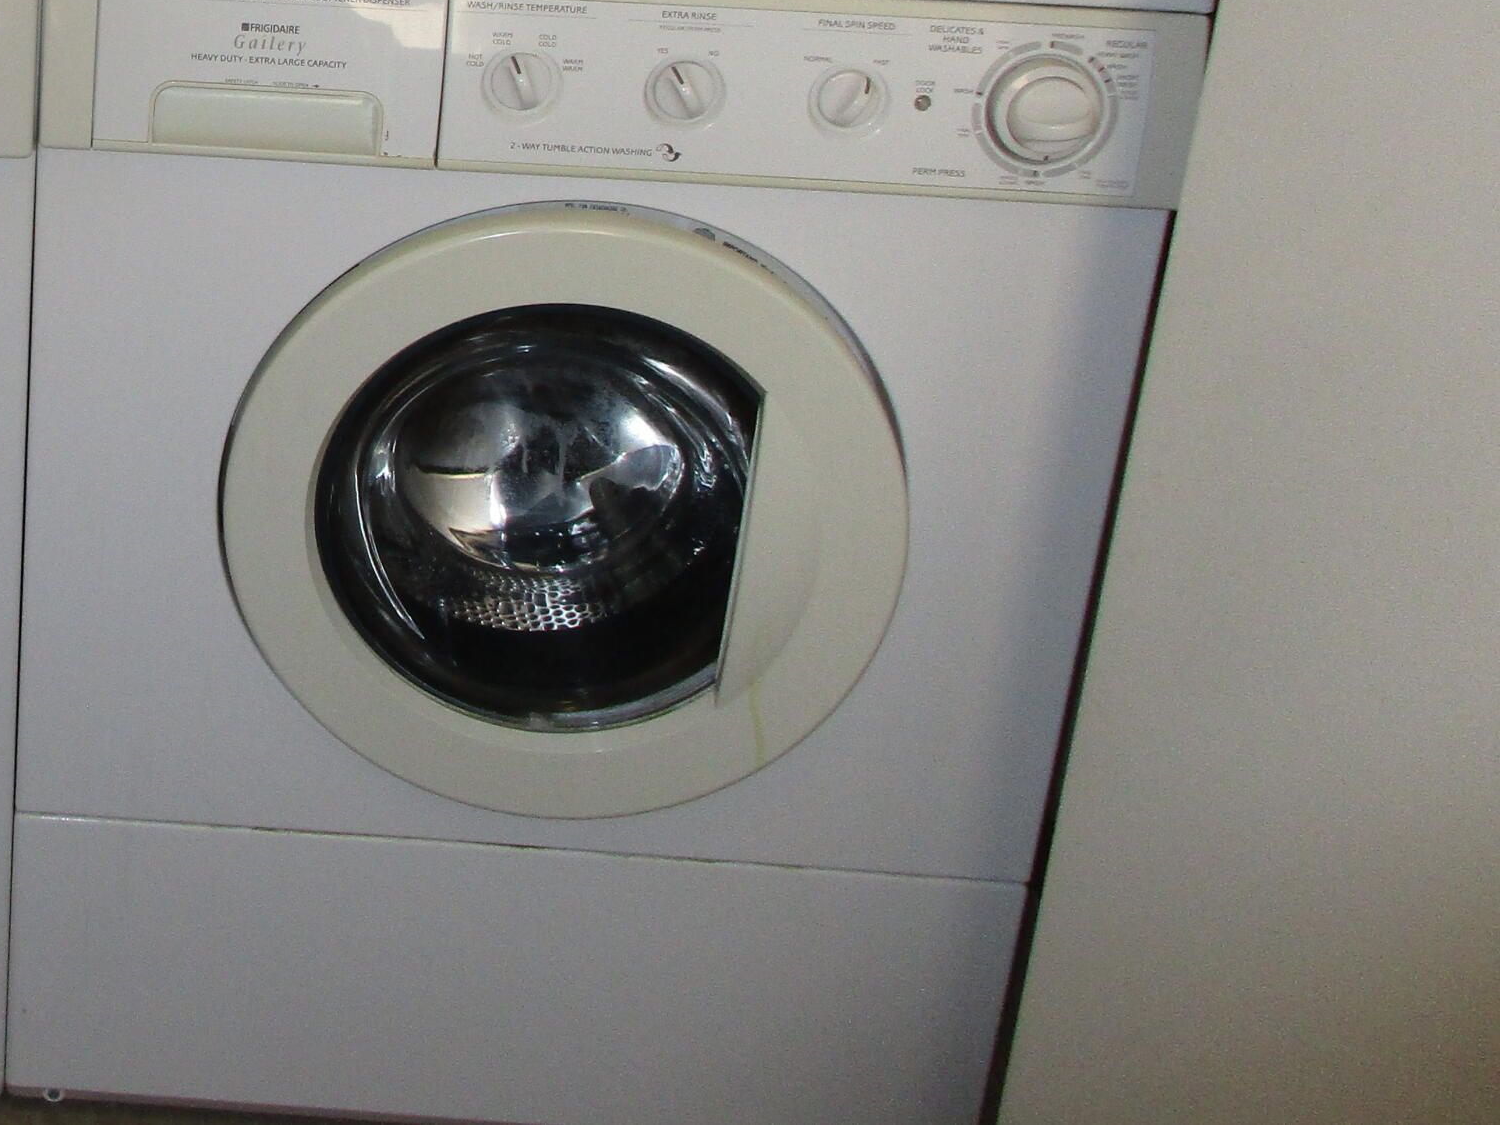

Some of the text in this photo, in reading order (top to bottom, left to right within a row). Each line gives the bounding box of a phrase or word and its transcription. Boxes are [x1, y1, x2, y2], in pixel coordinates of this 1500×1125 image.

[467, 1, 588, 14] WASH/RINSE TEMPERATURE
[661, 10, 717, 21] EXTRA RINSE
[249, 22, 301, 35] FRIGIDAIRE
[818, 19, 896, 31] FINAL SPIN SPEED
[930, 25, 975, 35] DELICATES
[233, 33, 308, 56] Gallery
[942, 36, 970, 44] HAND
[928, 44, 983, 54] WASHABLES
[190, 53, 219, 63] HEAVY
[220, 55, 243, 64] DUTY
[249, 56, 276, 65] EXTRA
[277, 57, 305, 67] LARGE
[306, 59, 348, 69] CAPACITY
[510, 141, 516, 150] 2
[521, 142, 541, 151] WAY
[542, 143, 576, 153] TUMBLE
[577, 145, 611, 155] ACTION
[611, 147, 653, 157] WASHING
